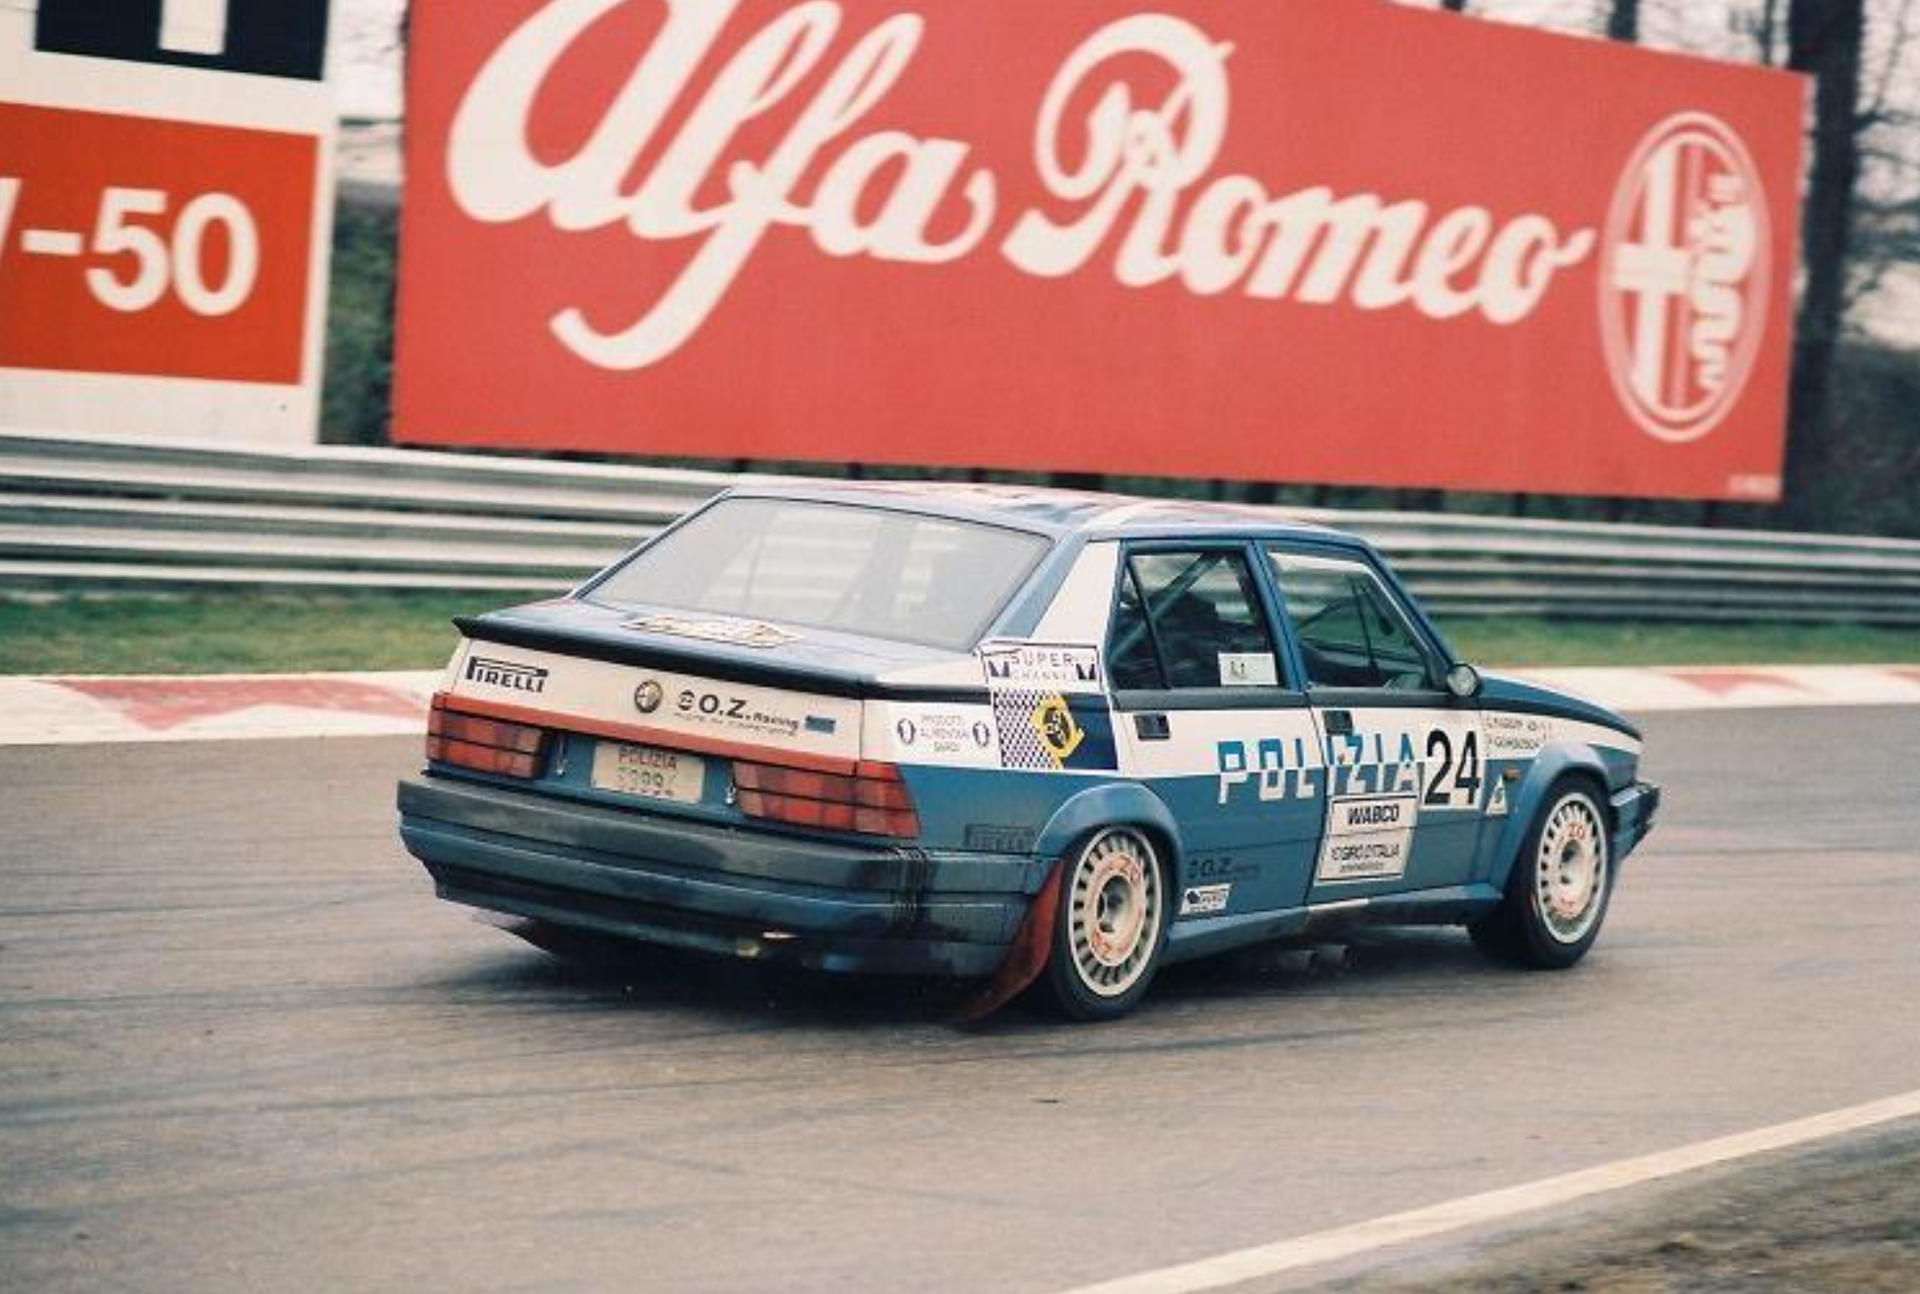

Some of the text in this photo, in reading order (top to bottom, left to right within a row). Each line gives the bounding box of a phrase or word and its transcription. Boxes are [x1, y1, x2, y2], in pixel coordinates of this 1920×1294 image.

[445, 0, 1596, 369] Alfa Romeo
[466, 656, 549, 693] PIRELLI
[1009, 651, 1074, 668] SUPER
[617, 745, 677, 770] POLIZIA
[1217, 733, 1420, 804] POLIZIA
[1425, 728, 1480, 805] 24
[1347, 804, 1400, 825] WABCO
